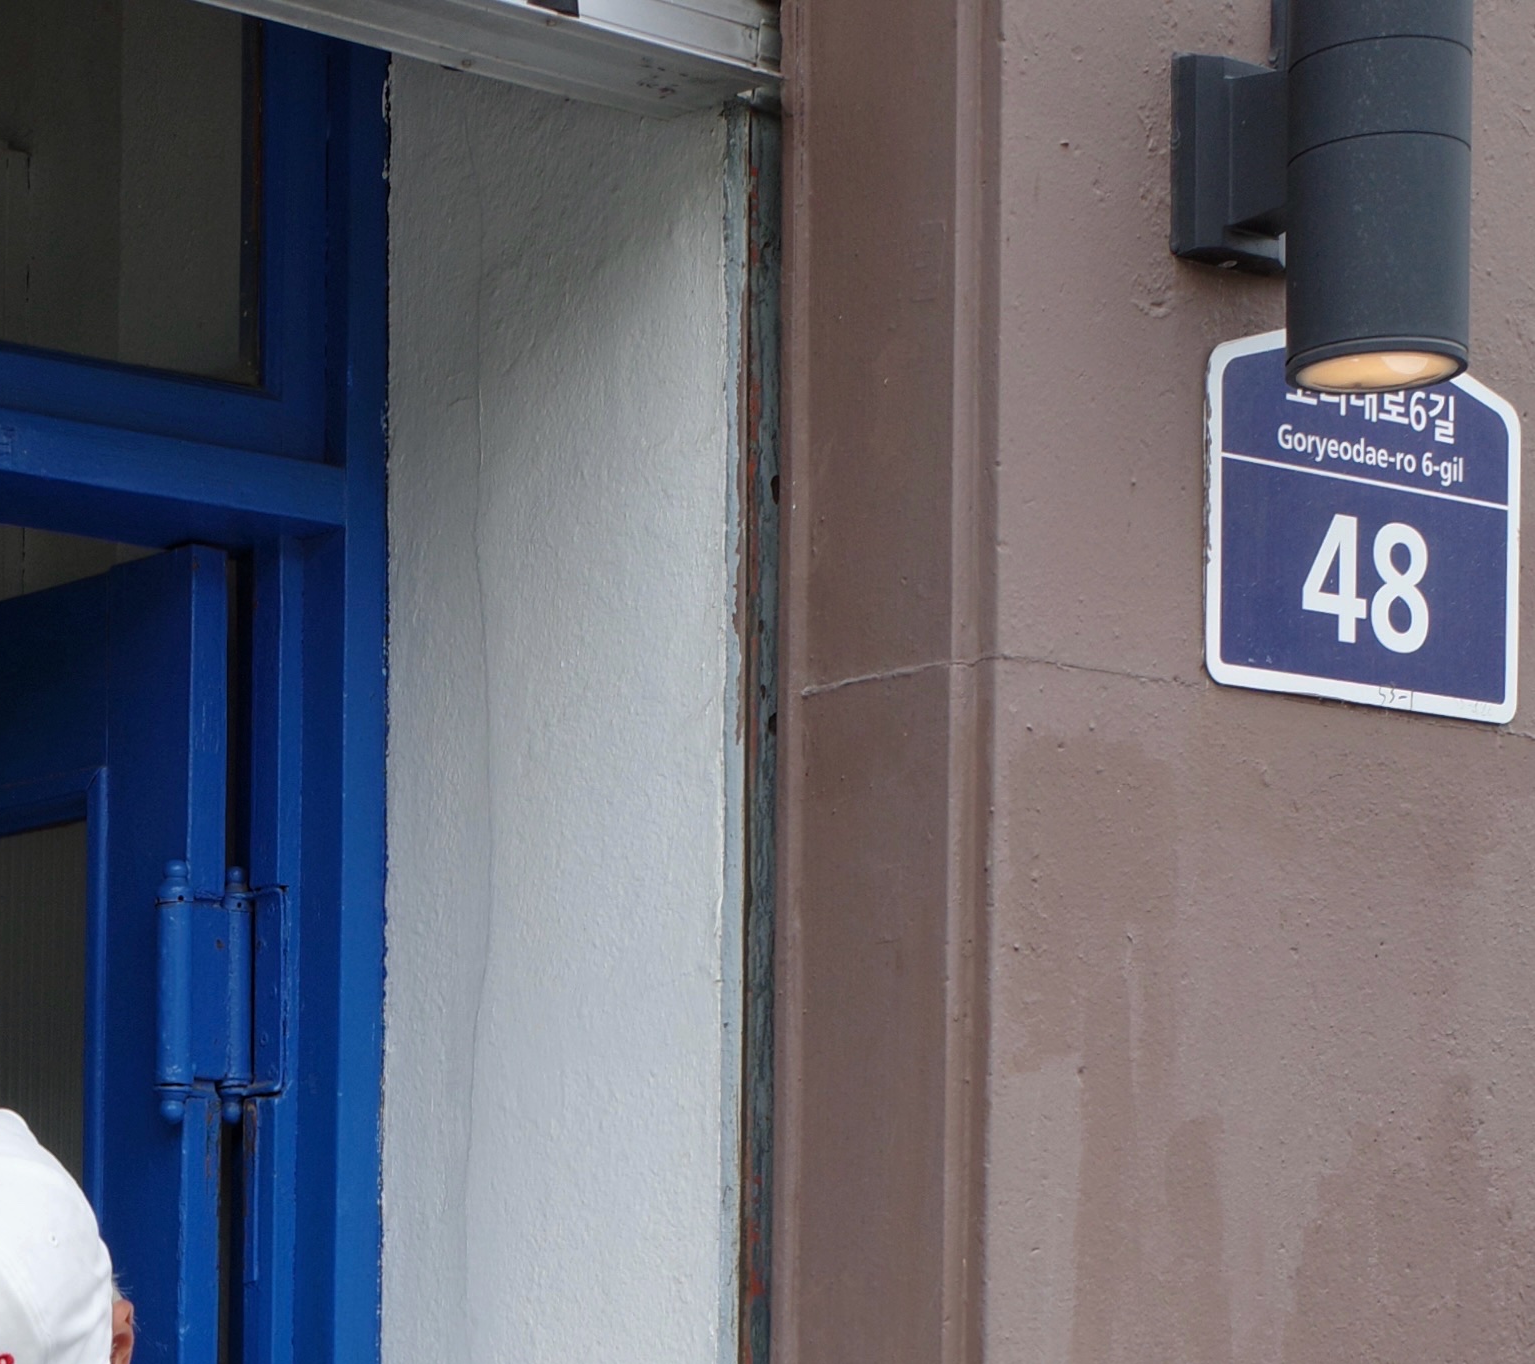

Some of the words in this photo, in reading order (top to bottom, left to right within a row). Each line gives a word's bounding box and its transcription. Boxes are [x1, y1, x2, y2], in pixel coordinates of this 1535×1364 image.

[1277, 423, 1417, 474] Goryeodae-ro
[1421, 452, 1464, 487] 6-gil
[1301, 513, 1429, 654] 48
